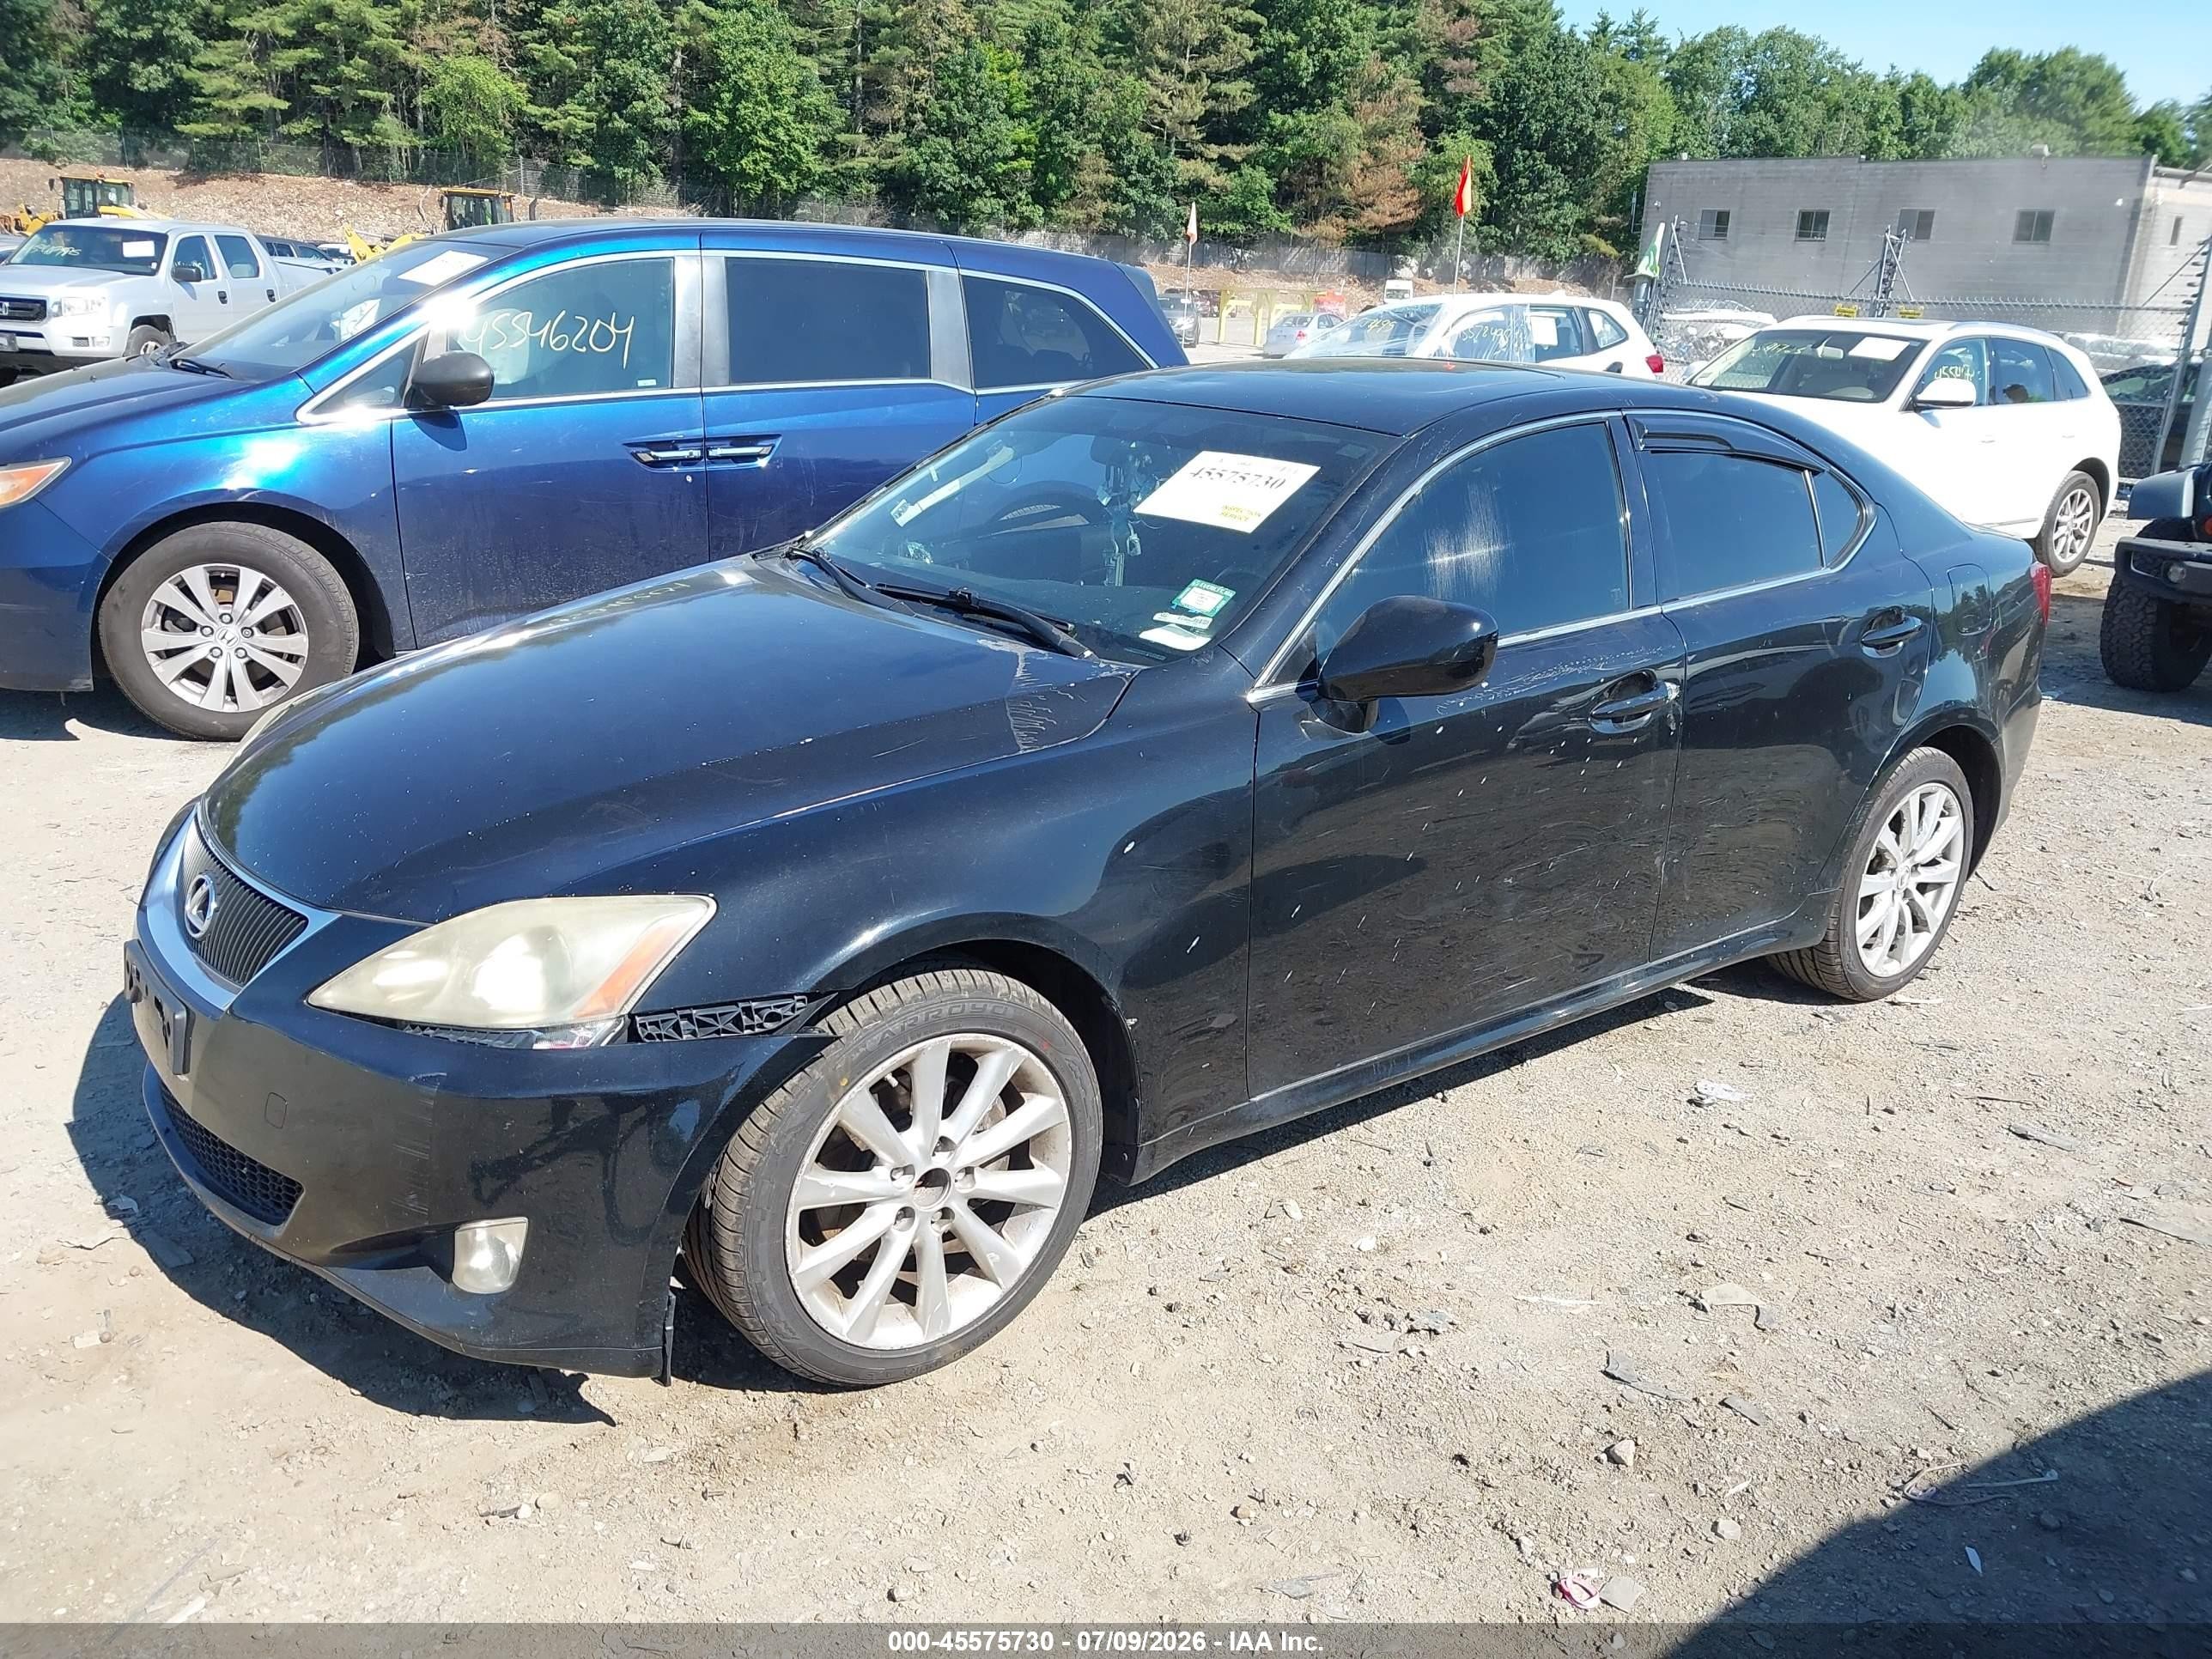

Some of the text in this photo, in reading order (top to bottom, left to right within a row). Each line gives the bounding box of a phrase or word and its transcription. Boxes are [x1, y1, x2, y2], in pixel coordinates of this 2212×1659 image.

[463, 310, 635, 370] 45546204
[1190, 467, 1286, 489] 45575730
[878, 1001, 1010, 1048] ARROYO
